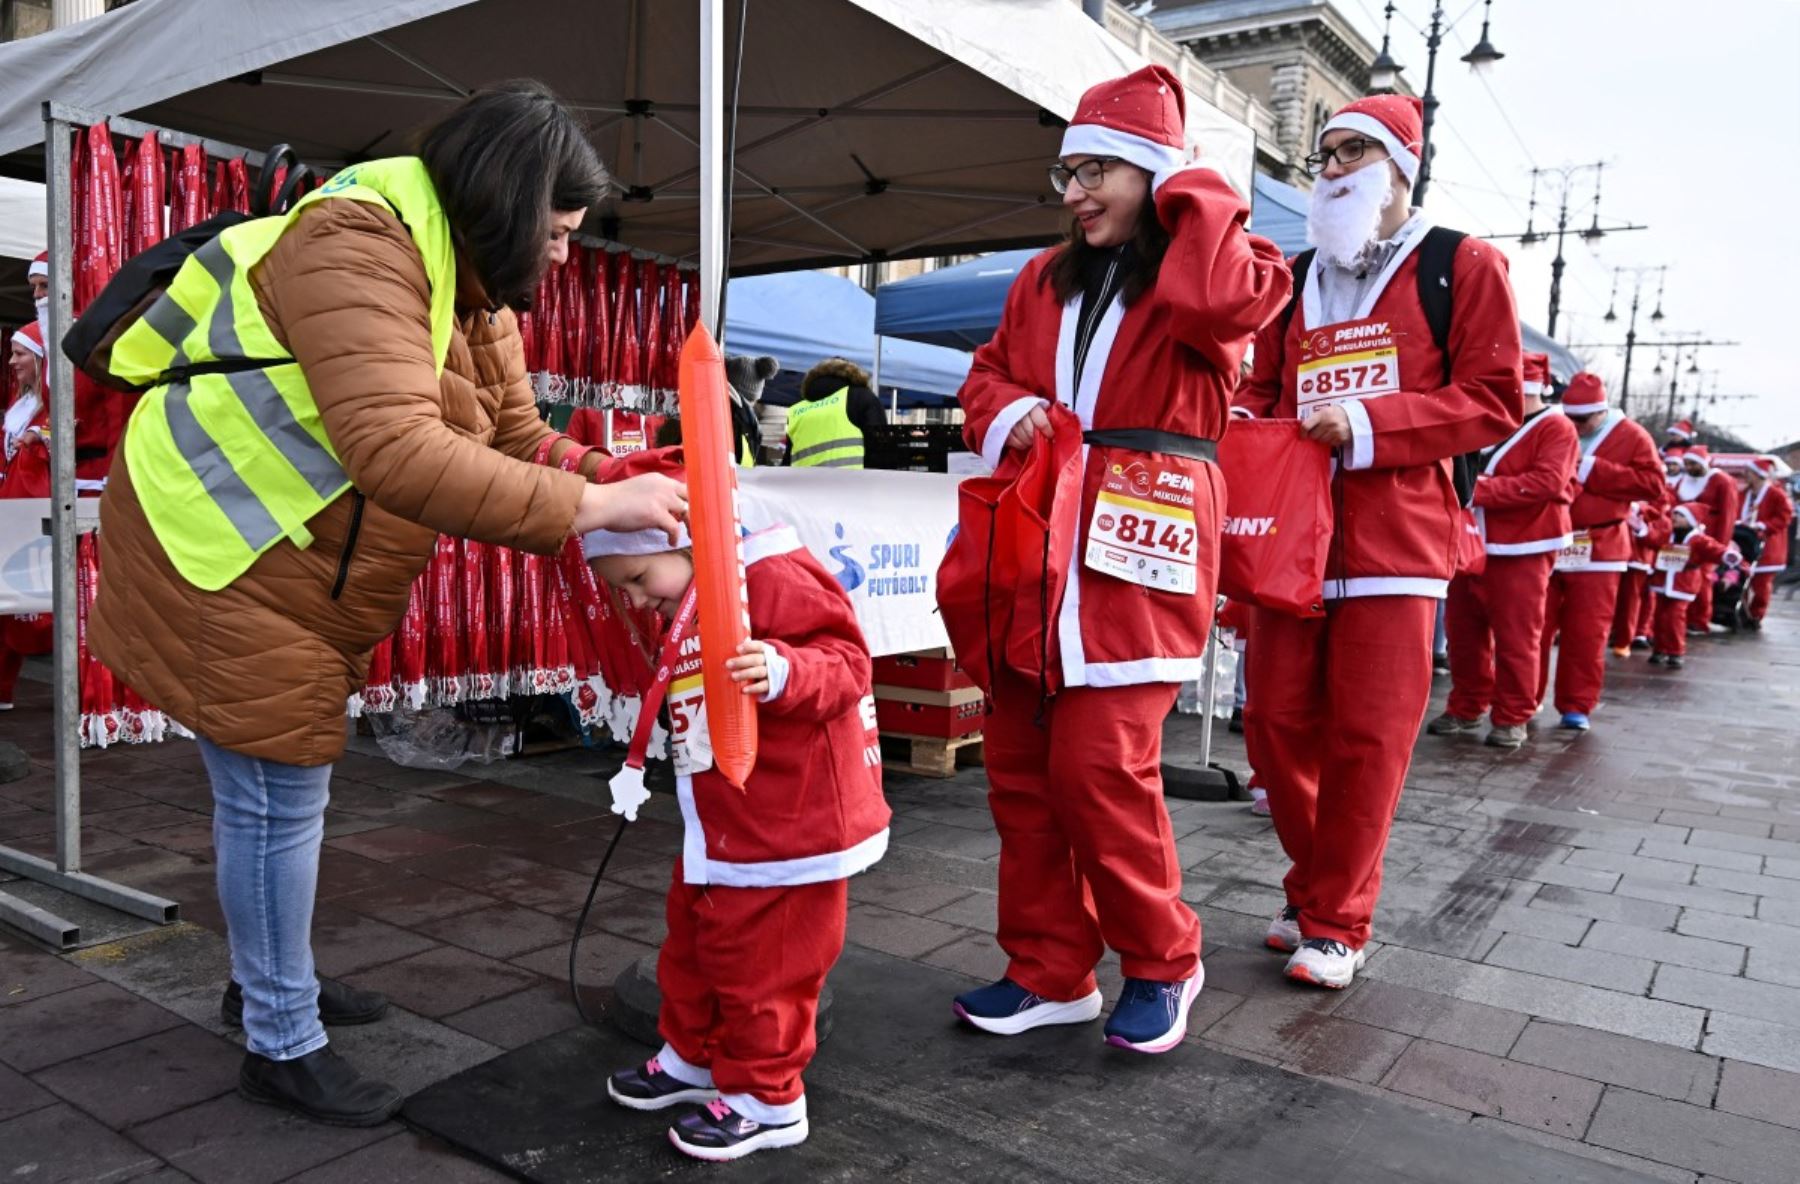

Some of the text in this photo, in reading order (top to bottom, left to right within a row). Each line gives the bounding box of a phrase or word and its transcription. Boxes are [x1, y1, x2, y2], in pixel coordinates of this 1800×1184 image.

[1316, 363, 1388, 394] 8572
[1157, 471, 1194, 491] PEN
[1116, 514, 1195, 556] 8142
[868, 544, 920, 569] SPURI
[868, 571, 928, 598] FUTÓBOLT
[670, 695, 704, 734] 57
